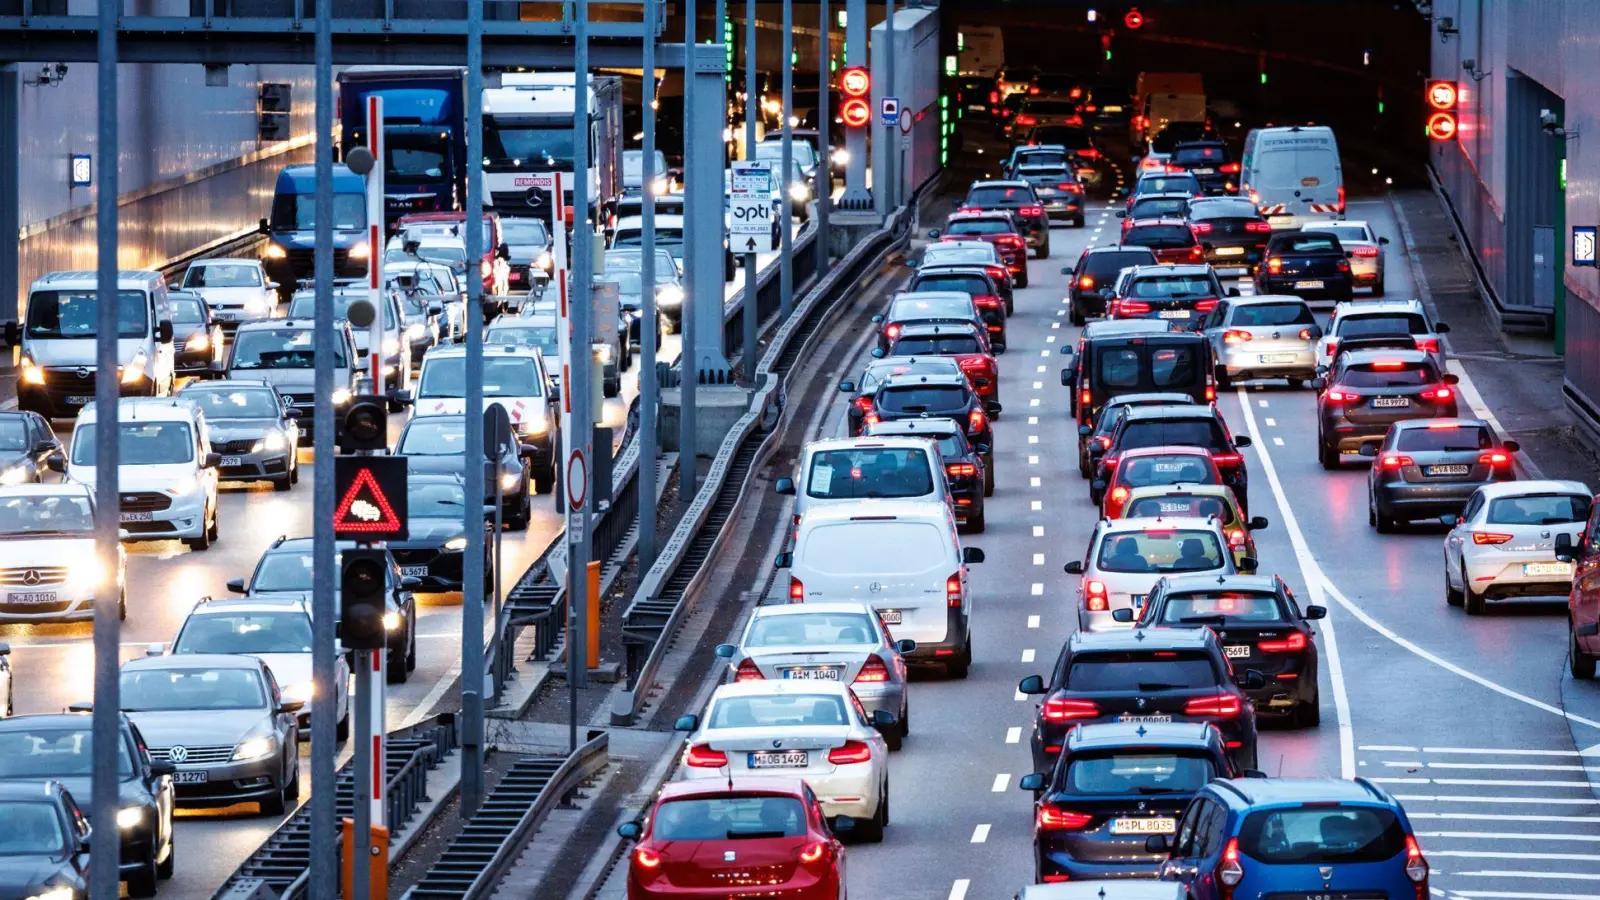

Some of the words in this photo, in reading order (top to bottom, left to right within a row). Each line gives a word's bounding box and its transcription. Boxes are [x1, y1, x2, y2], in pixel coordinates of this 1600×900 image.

[515, 178, 551, 186] REMONDIS
[35, 593, 54, 602] 1016
[813, 670, 836, 679] 1040
[754, 755, 762, 765] M
[781, 753, 806, 764] 1492
[182, 772, 207, 782] 1270
[1117, 821, 1124, 829] M
[1131, 820, 1144, 830] PL
[1146, 820, 1173, 830] 8035
